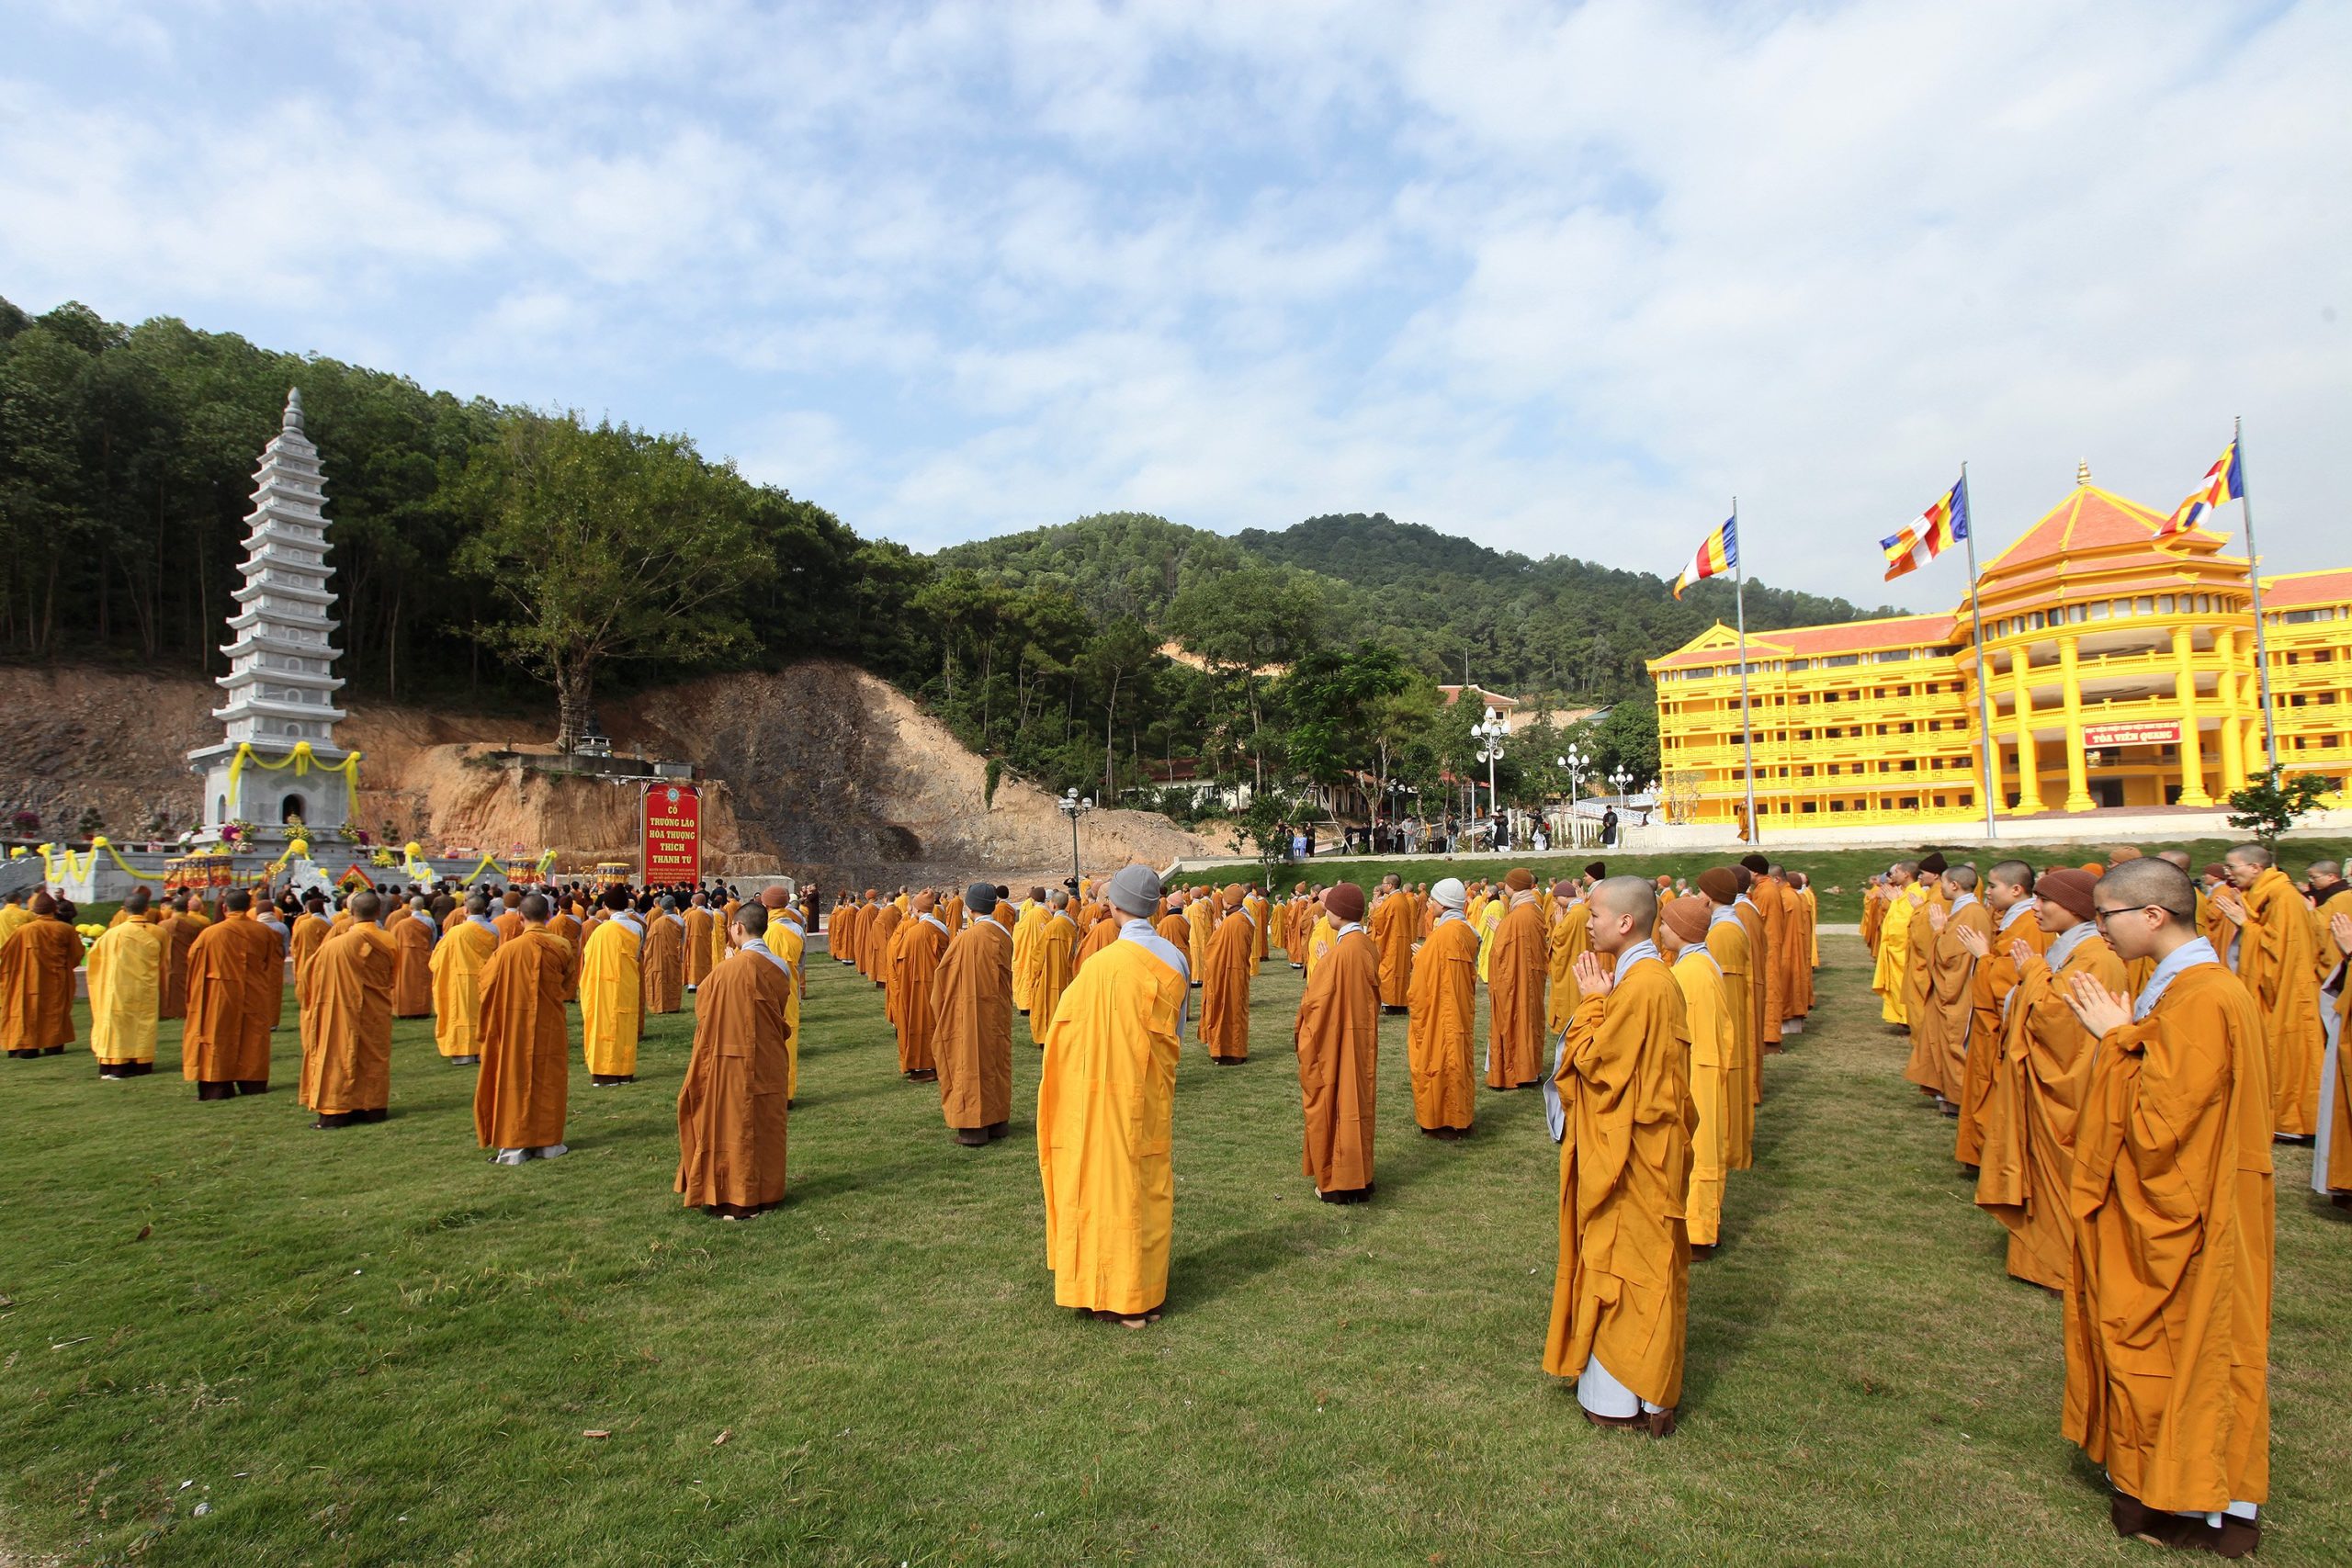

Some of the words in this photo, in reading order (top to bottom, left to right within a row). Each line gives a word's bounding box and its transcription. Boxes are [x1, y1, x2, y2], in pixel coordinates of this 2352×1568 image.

[2139, 731, 2173, 742] QUANG
[660, 841, 685, 852] THÍCH
[652, 854, 680, 863] THANH
